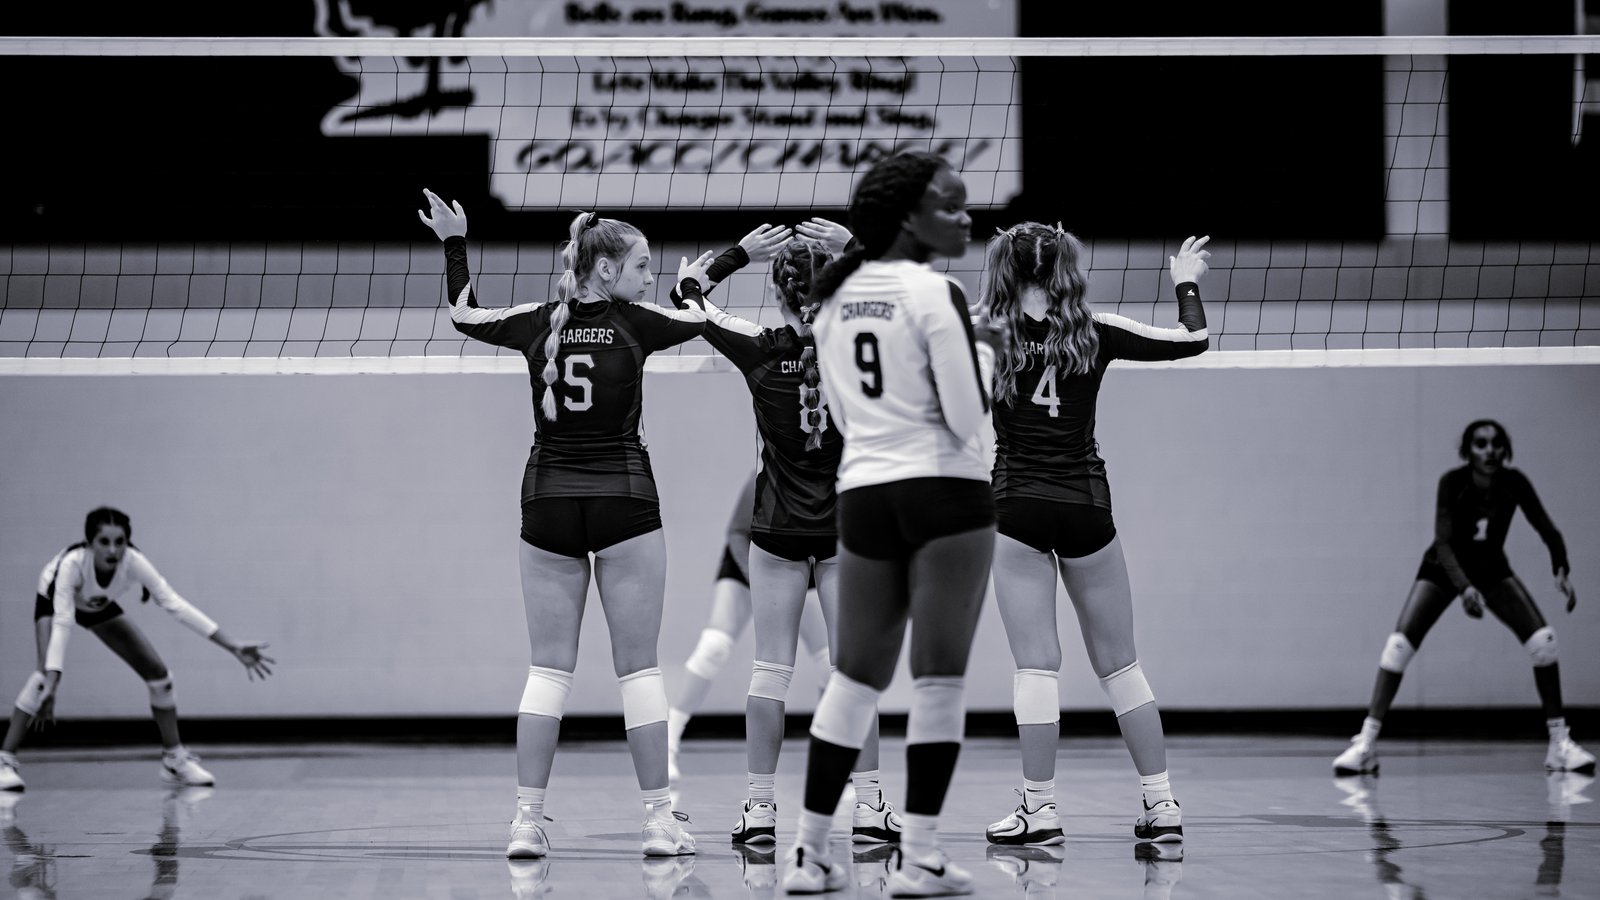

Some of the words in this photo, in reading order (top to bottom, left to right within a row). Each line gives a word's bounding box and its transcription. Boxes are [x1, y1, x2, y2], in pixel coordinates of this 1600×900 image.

[558, 327, 615, 345] HARGERS
[563, 354, 595, 411] 5
[854, 332, 883, 398] 9
[1031, 364, 1061, 417] 4
[1473, 518, 1489, 541] 1
